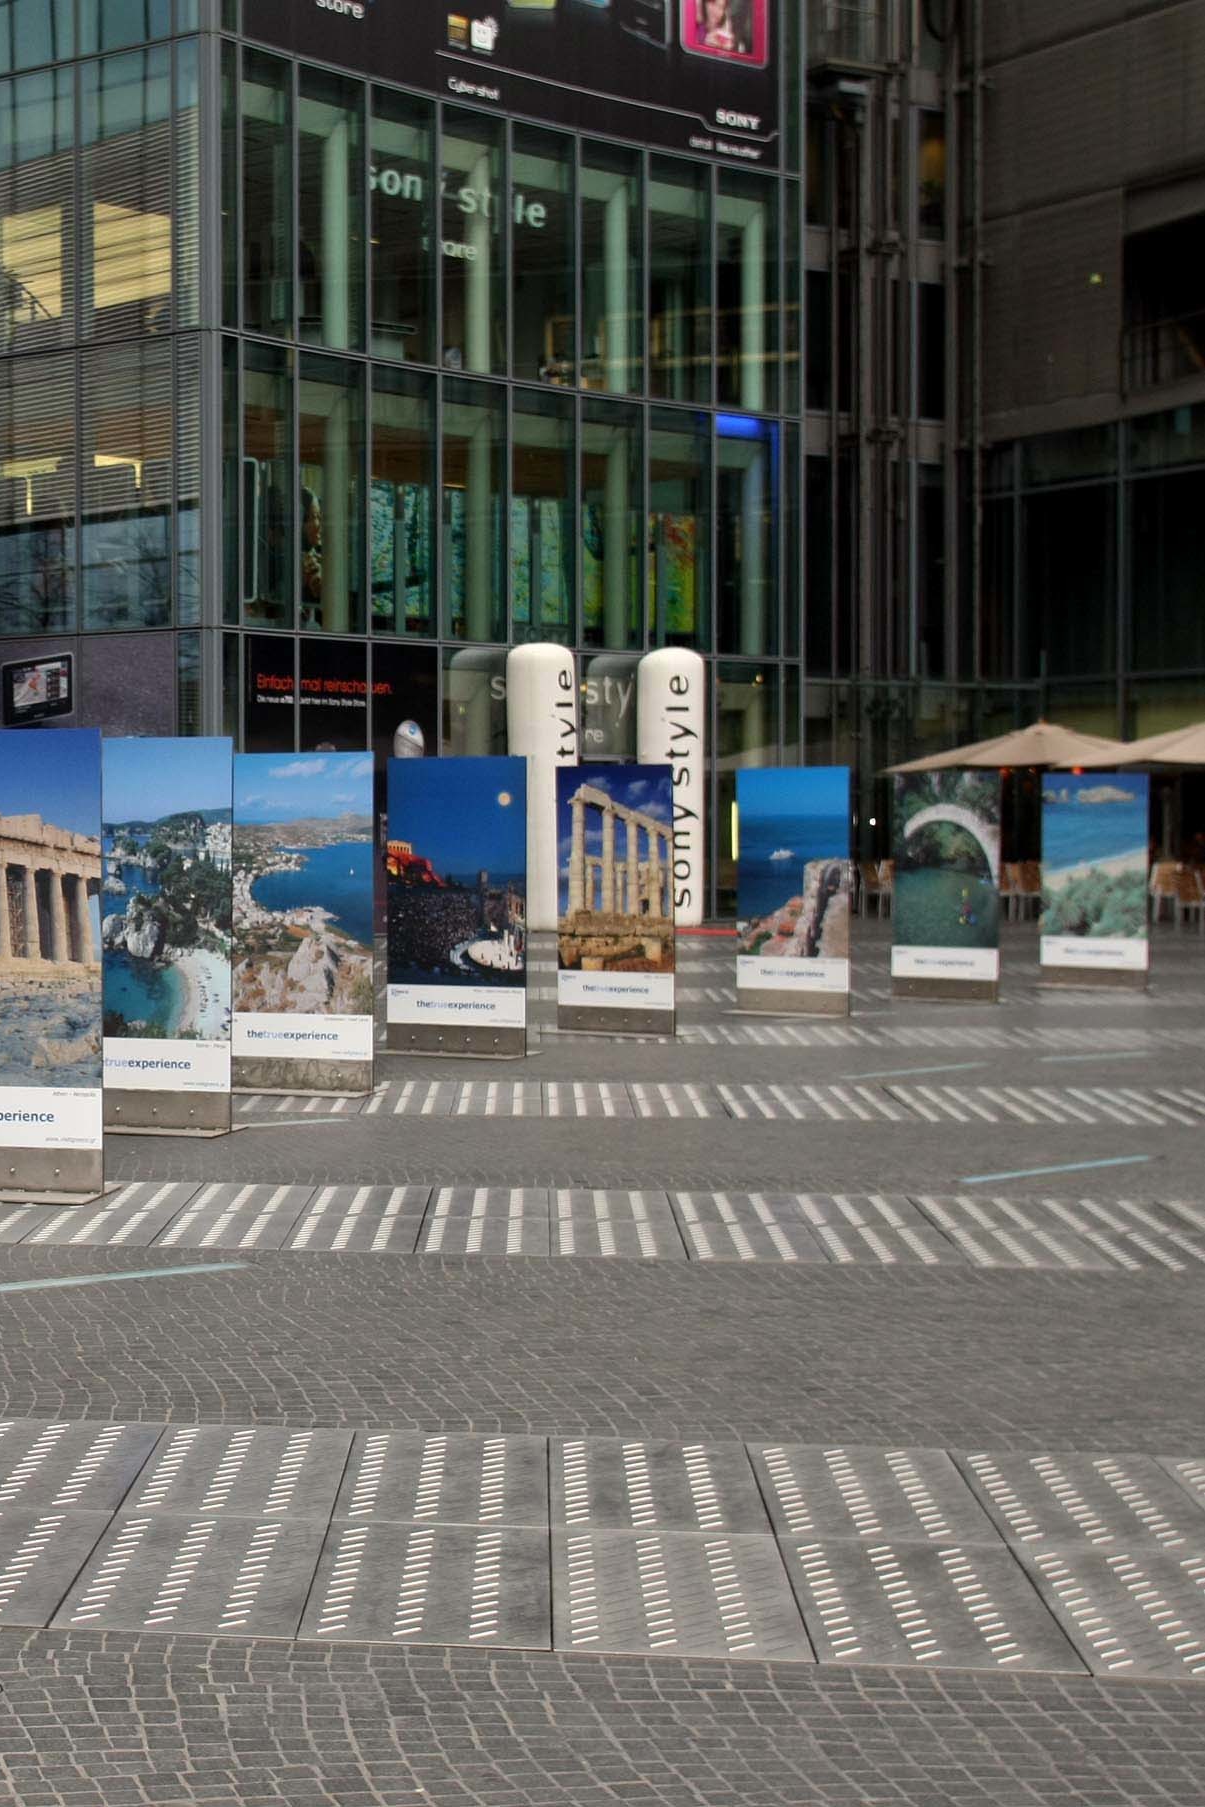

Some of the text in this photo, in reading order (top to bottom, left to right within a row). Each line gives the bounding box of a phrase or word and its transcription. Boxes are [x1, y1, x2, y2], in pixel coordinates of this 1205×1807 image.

[716, 107, 761, 130] SONY
[665, 673, 699, 909] sony style
[246, 1029, 339, 1042] thetrueexperience
